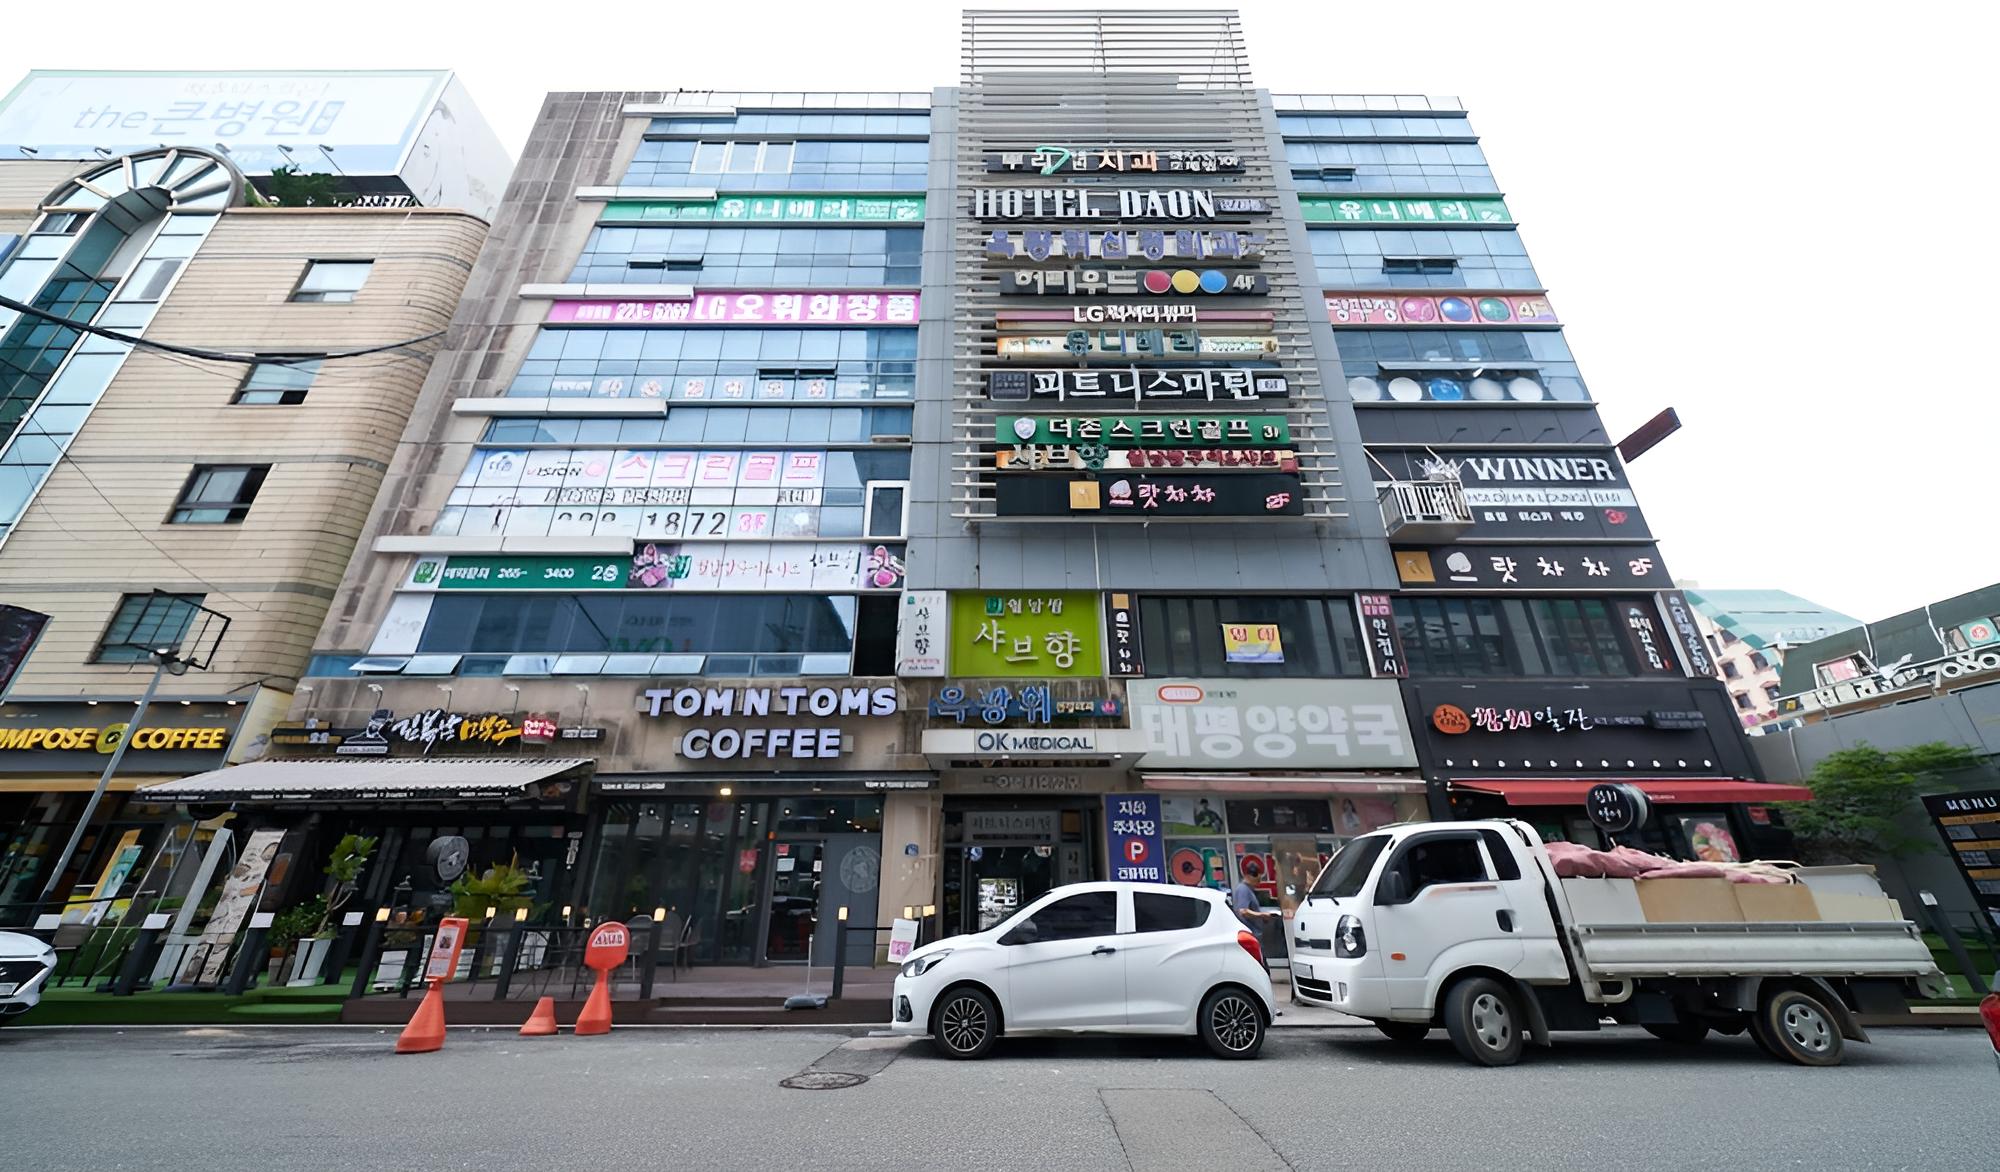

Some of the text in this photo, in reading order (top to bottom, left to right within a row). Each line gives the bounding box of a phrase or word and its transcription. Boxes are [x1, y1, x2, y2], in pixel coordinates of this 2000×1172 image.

[974, 189, 1100, 218] HOTEL
[1118, 189, 1218, 218] DAON
[1465, 457, 1617, 482] WINNER
[973, 619, 1083, 669] 샤브향
[643, 686, 898, 718] TOM N TOMS
[0, 727, 226, 750] MPOSE COFFEE
[681, 727, 841, 759] COFFEE
[977, 732, 1094, 752] OK MEDICAL
[1142, 703, 1404, 760] 태평양약국
[1130, 841, 1145, 861] P
